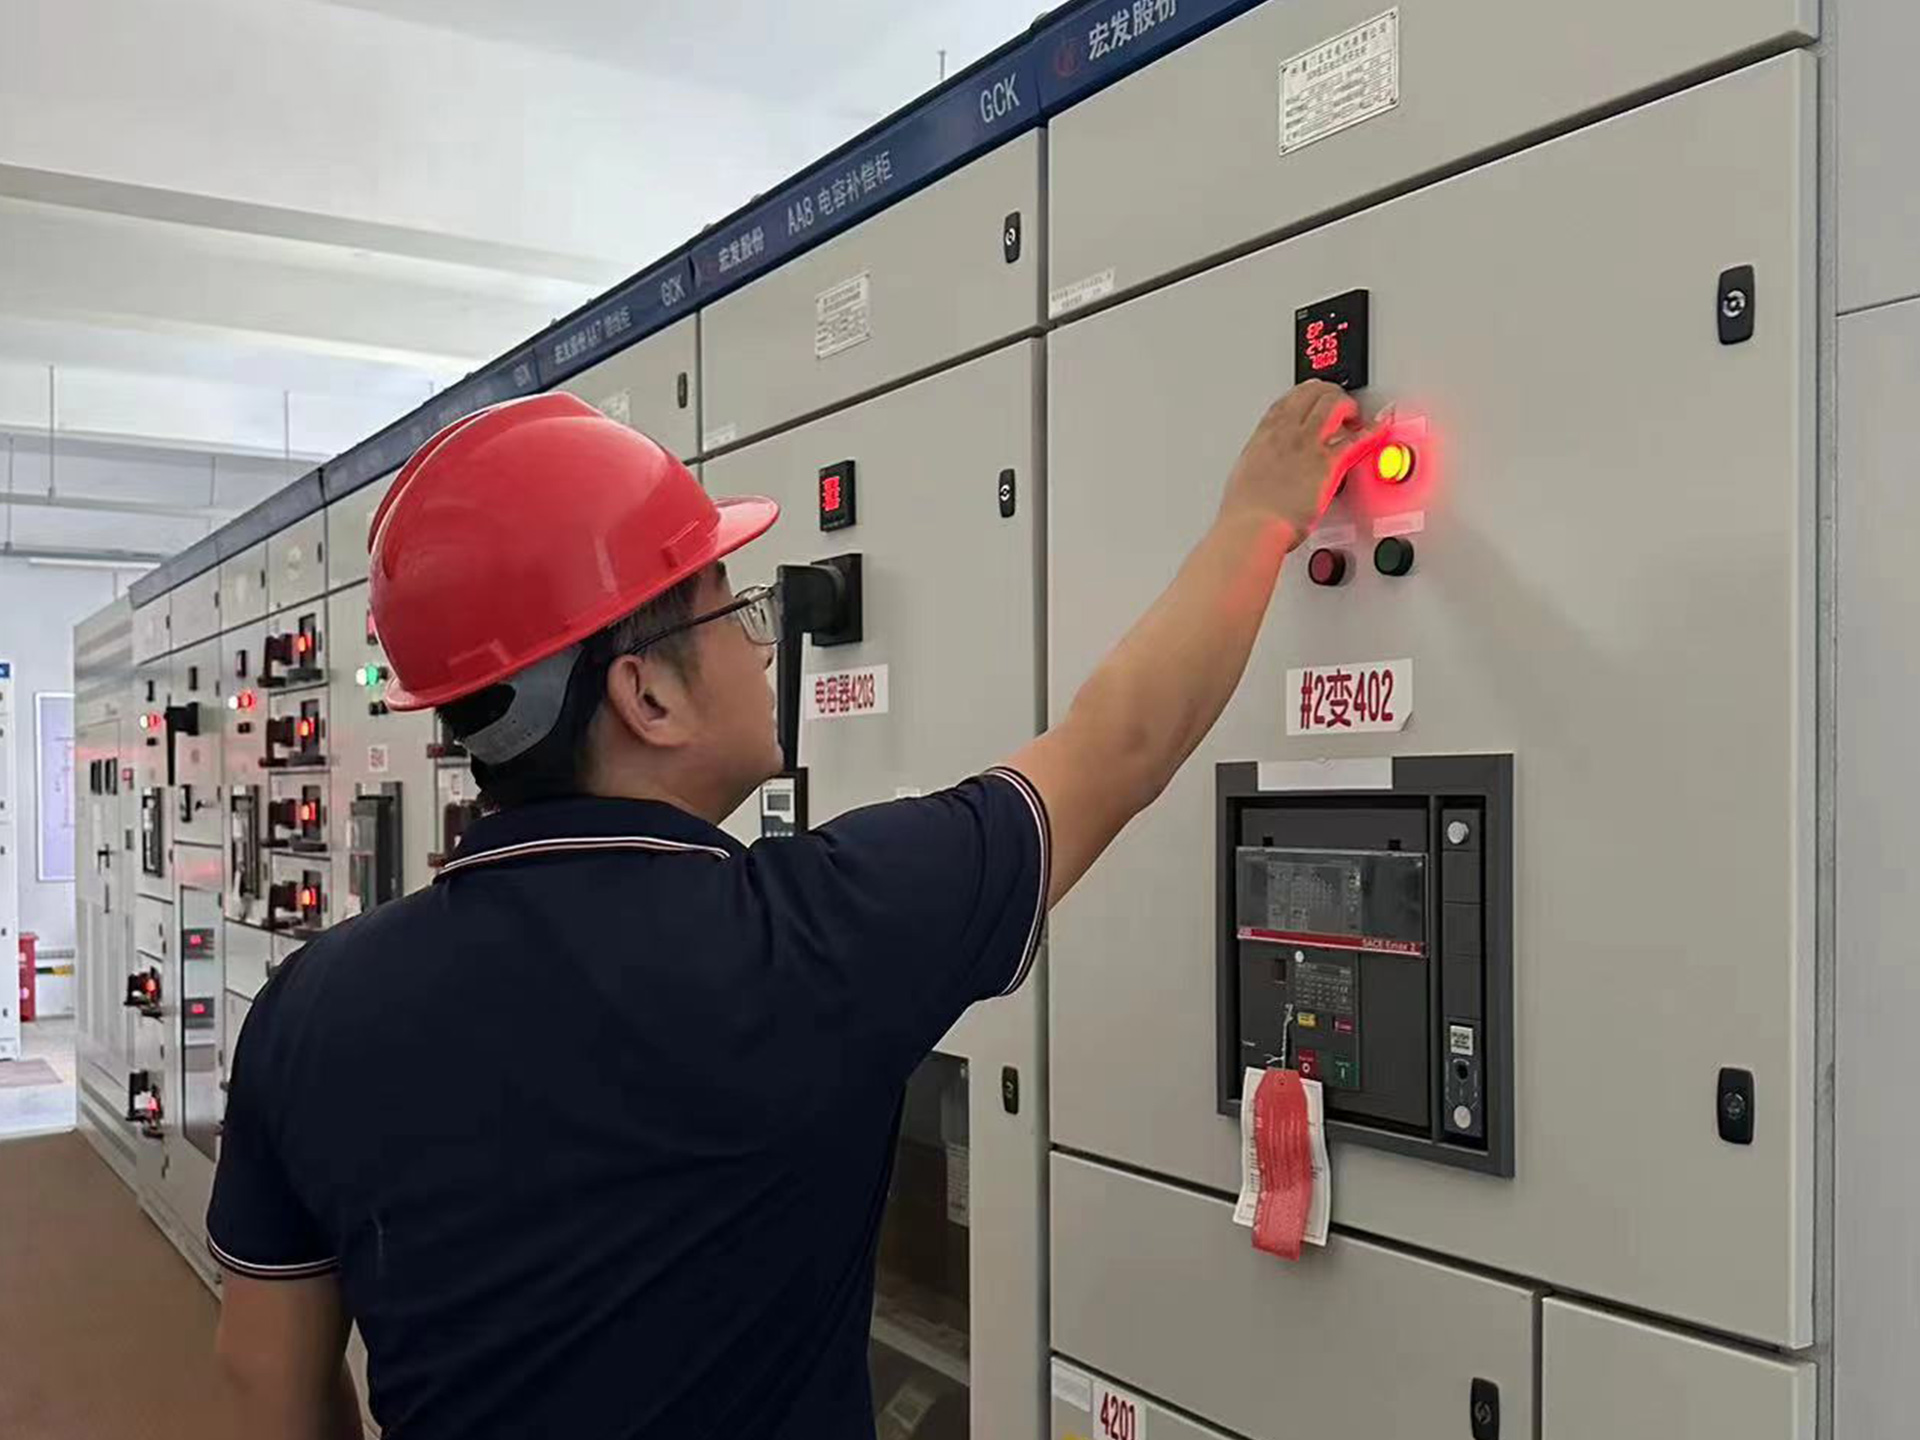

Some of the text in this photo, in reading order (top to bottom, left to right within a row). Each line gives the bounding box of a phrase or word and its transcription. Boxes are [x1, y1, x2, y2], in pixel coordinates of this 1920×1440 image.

[1088, 0, 1177, 61] 宏发股份
[980, 73, 1020, 123] GCK
[787, 197, 815, 236] AA8
[818, 151, 893, 215] 电容补偿柜
[815, 673, 875, 714] 电容器4203
[1300, 668, 1393, 729] #2变402
[1100, 1391, 1136, 1440] 4201
